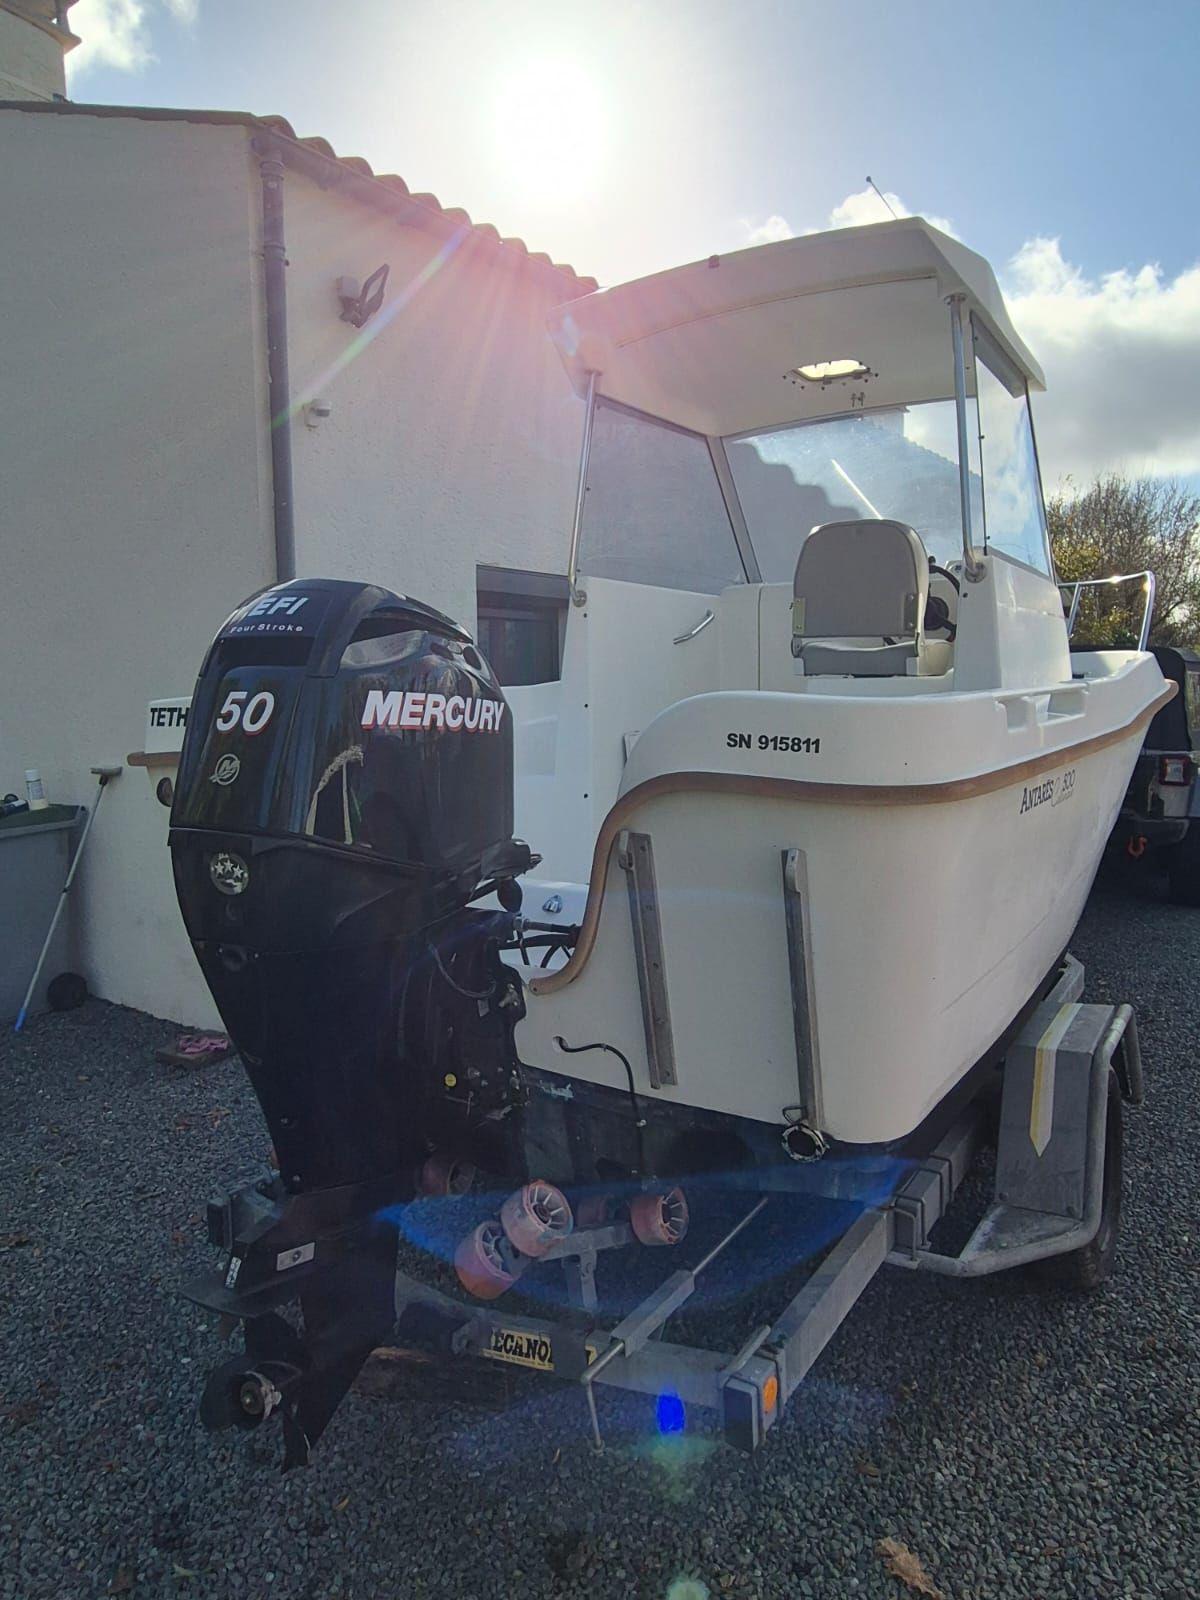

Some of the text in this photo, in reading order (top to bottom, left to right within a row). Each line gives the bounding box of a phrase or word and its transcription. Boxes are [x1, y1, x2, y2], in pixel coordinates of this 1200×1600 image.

[247, 596, 309, 617] EFI
[257, 623, 304, 632] Stroke
[216, 691, 275, 735] 50
[360, 690, 505, 733] MERCURY
[726, 732, 820, 754] SN 915811
